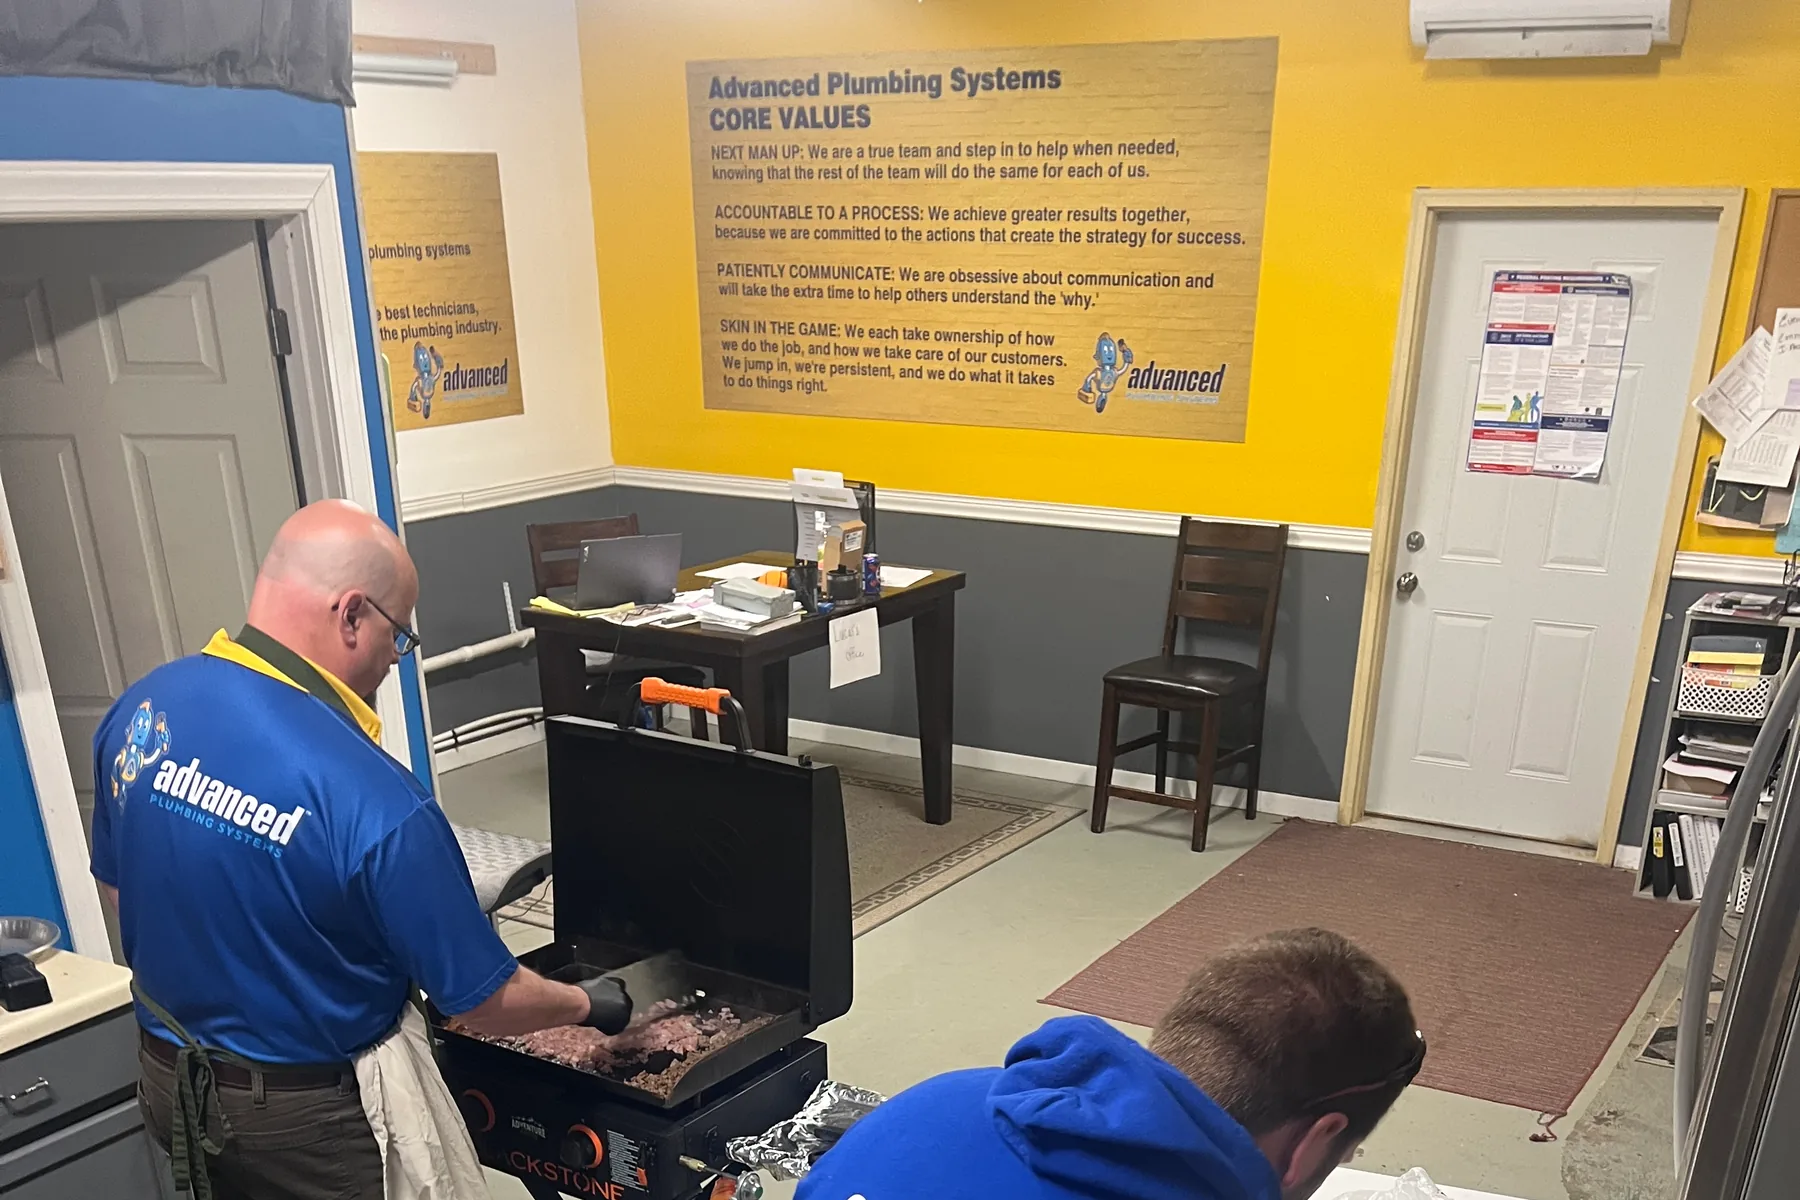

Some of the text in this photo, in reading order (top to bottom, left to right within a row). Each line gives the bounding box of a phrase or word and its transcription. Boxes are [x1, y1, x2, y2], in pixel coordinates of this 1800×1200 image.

[709, 67, 1061, 99] Advanced Plumbing Systems
[710, 104, 870, 131] CORE VALUES
[711, 138, 1179, 161] NEXT MAN UP: We are a true team and step in to help when needed,
[712, 162, 1149, 183] knowing that the rest of the team will do the same for each of us.
[715, 205, 1189, 225] ACCOUNTABLE TO A PROCESS: We achieve greater results together,
[715, 225, 1245, 247] because we are committed to the actions that create the strategy for success.
[369, 243, 471, 262] plumbing systems
[718, 263, 1214, 288] PATIENTLY COMMUNICATE: We are obsessive about communication and
[719, 282, 738, 295] will
[742, 283, 767, 296] take
[771, 284, 789, 297] the
[794, 285, 823, 298] extra
[827, 285, 854, 299] time
[858, 287, 870, 299] to
[875, 287, 901, 304] help
[906, 288, 947, 302] others
[952, 289, 1029, 304] understand
[1035, 291, 1056, 305] the
[385, 305, 410, 320] best
[413, 301, 479, 318] technicians,
[380, 319, 501, 343] the plumbing industry.
[720, 319, 1054, 347] SKIN IN THE GAME: We each take ownership of how
[722, 339, 1067, 366] we do the job, and how we take care of our customers.
[444, 358, 508, 391] advanced
[722, 356, 1054, 385] We jump in, we're persistent, and we do what it takes
[1128, 360, 1226, 393] advanced
[724, 374, 827, 394] to do things right.
[149, 793, 283, 859] PLUMBING SYSTEMS
